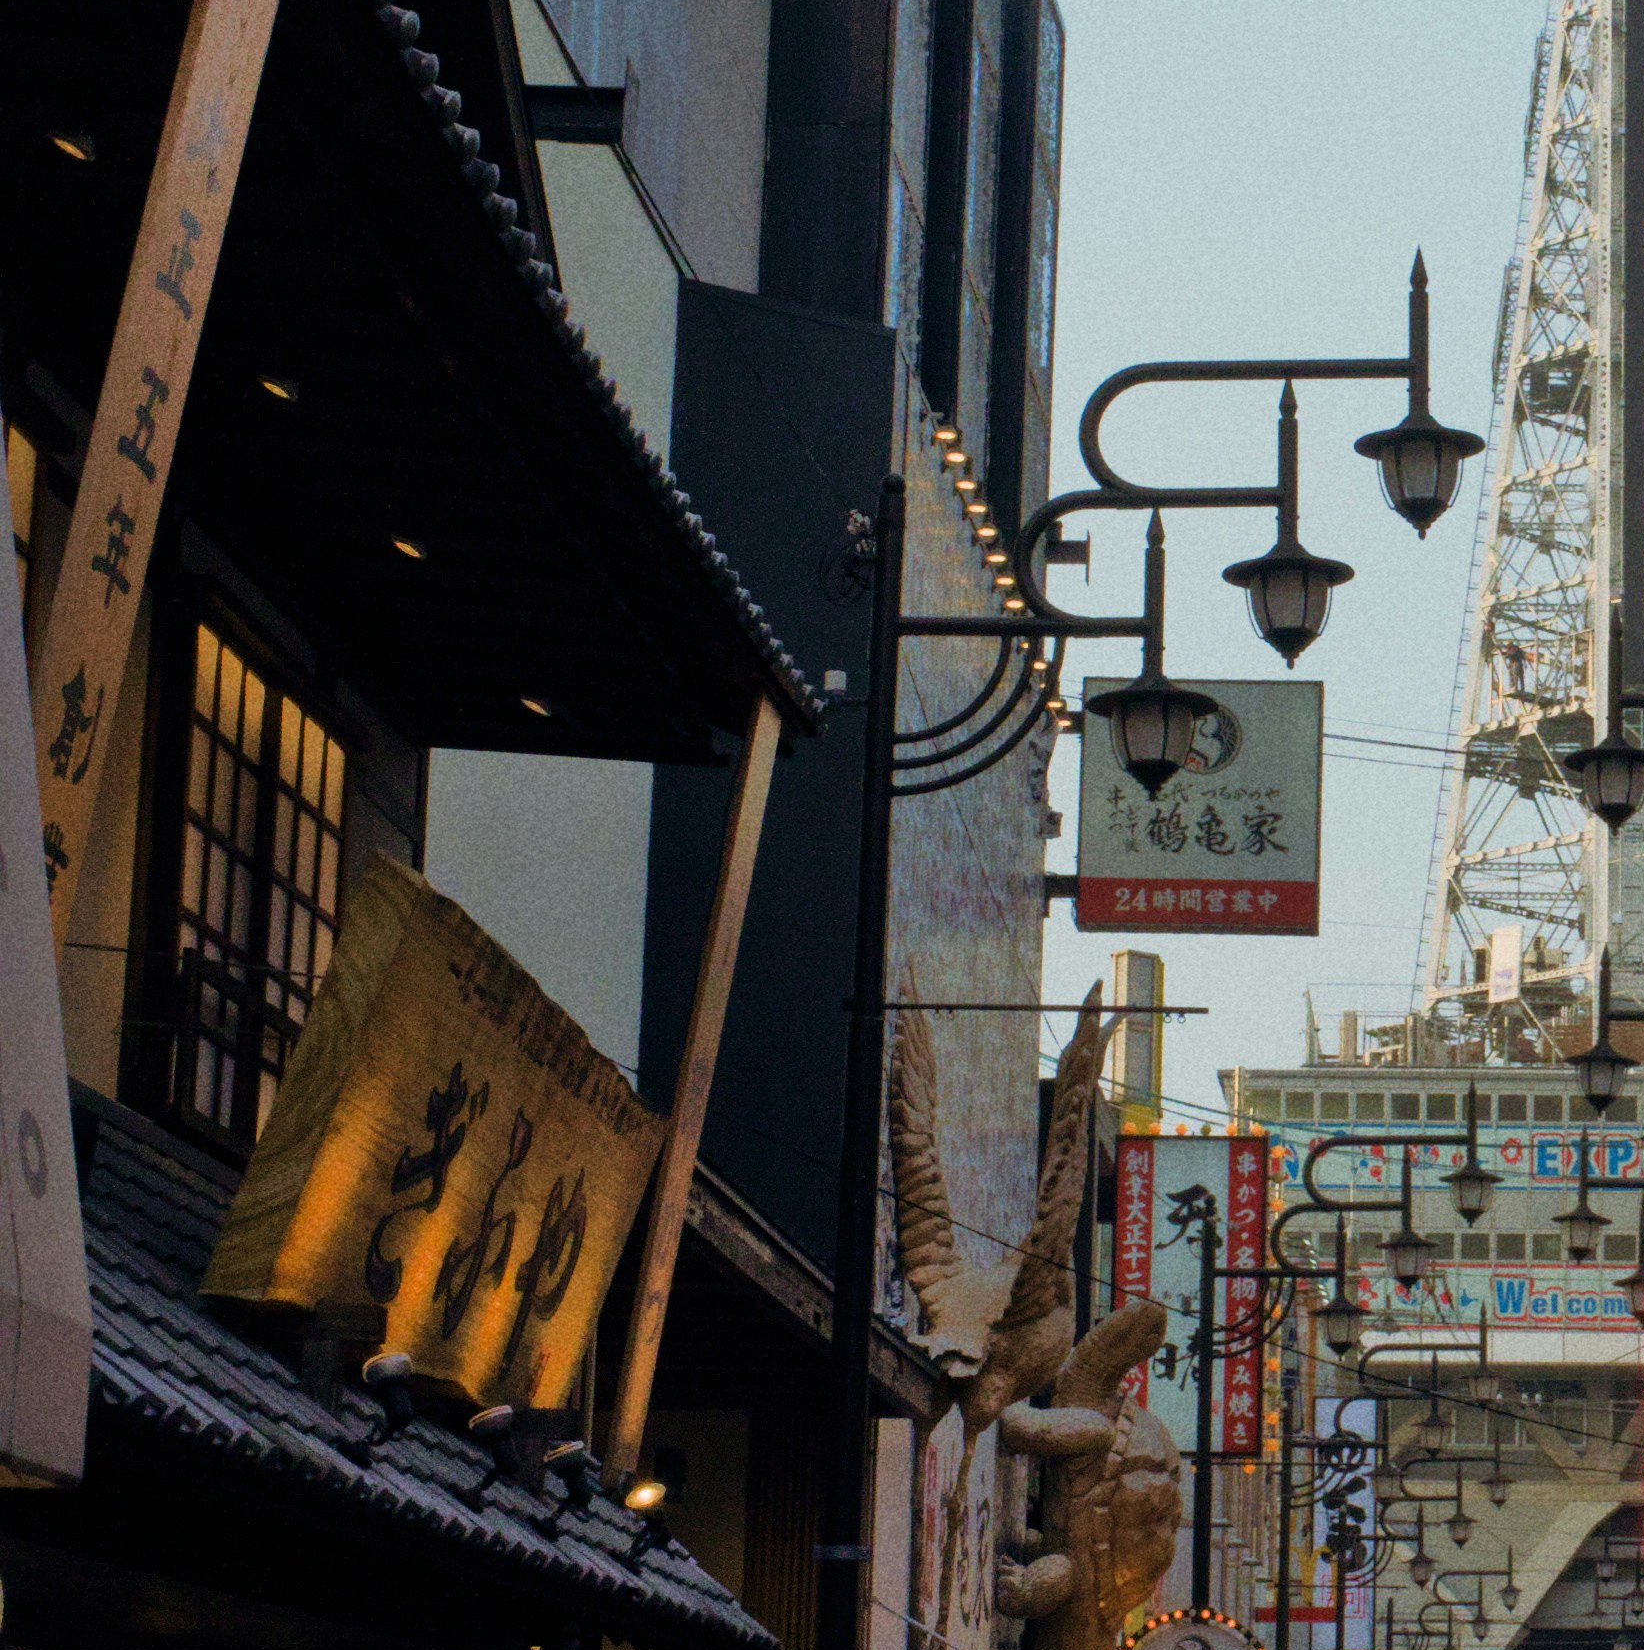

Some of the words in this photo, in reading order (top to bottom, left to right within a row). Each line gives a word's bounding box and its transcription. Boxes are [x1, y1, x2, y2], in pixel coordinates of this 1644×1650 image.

[1147, 802, 1290, 856] 鶴亀家
[1114, 886, 1280, 916] 24時間営業中
